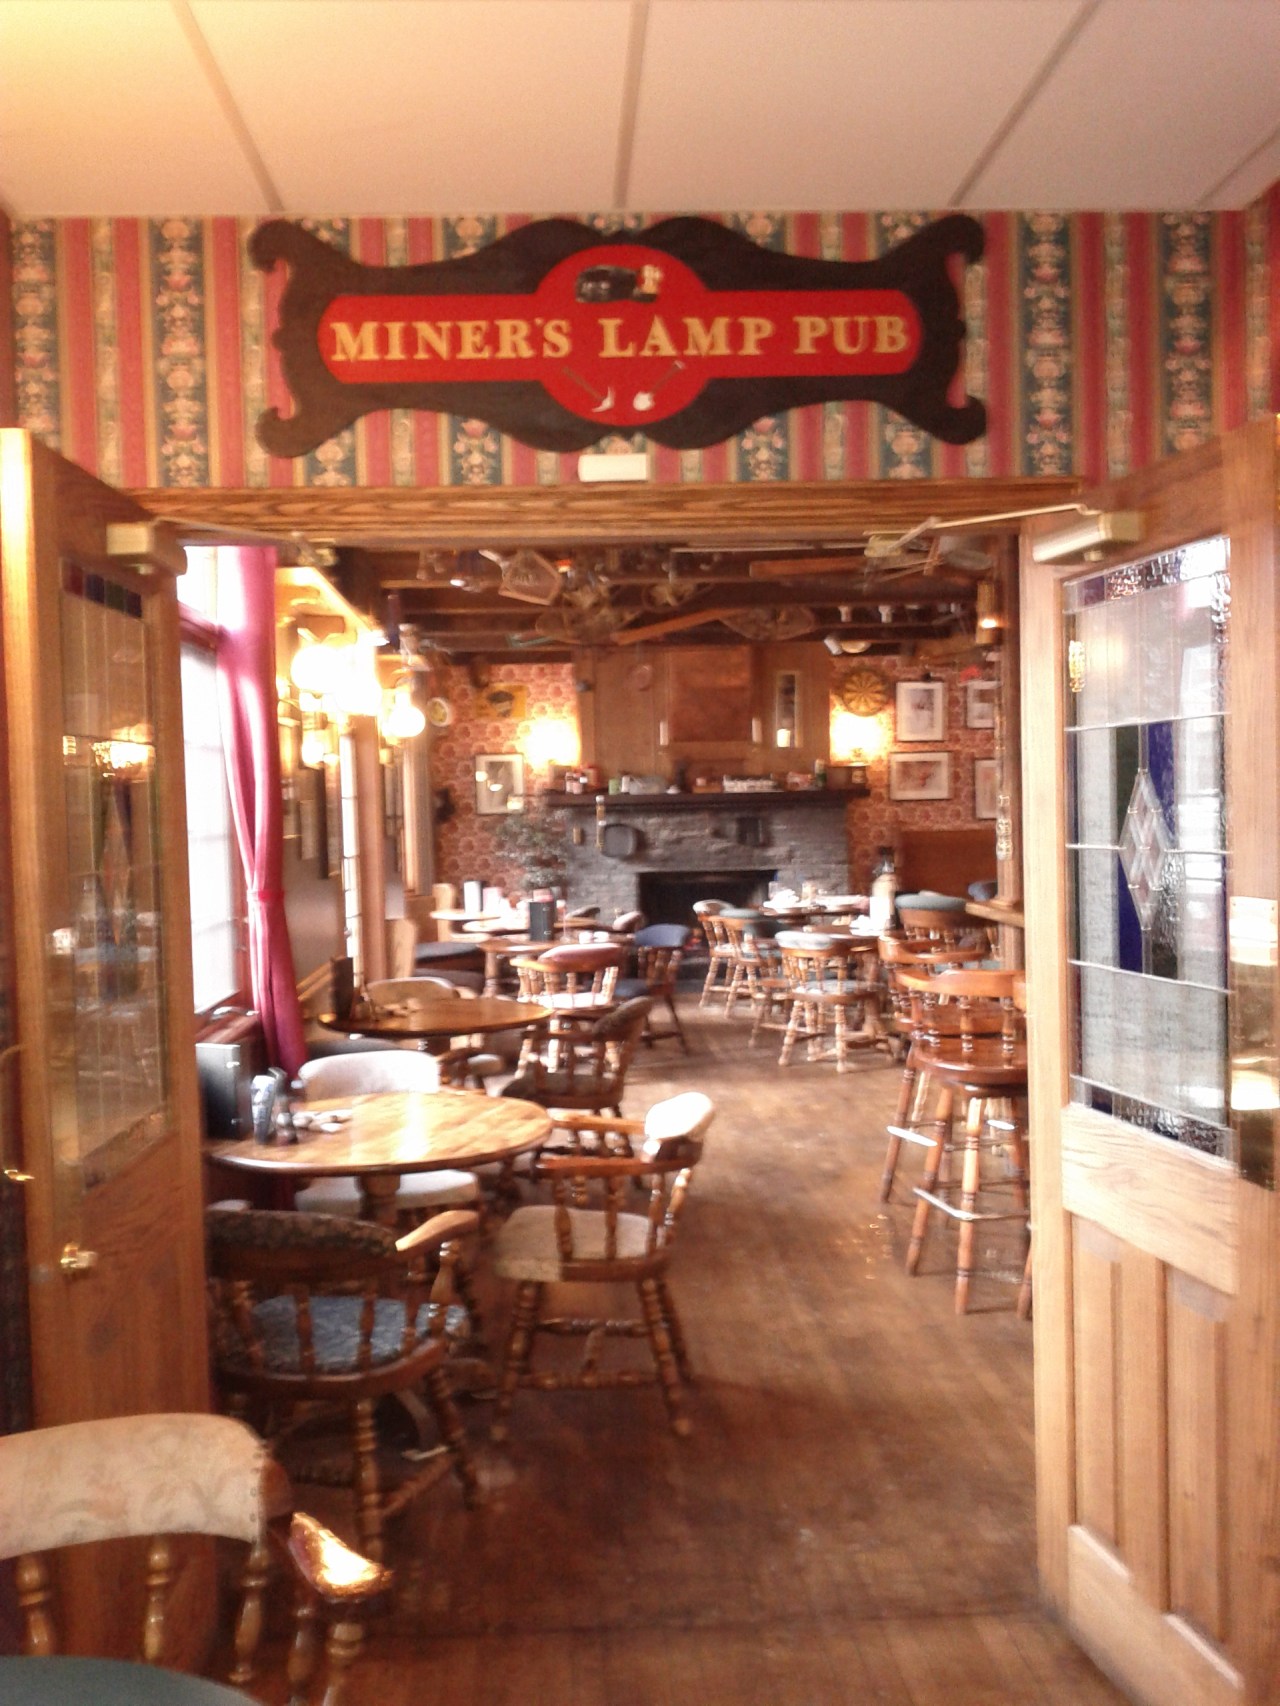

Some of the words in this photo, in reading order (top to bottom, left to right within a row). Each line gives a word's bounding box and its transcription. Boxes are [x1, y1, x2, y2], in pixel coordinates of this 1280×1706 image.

[330, 318, 572, 363] MINER'S
[598, 315, 774, 359] LAMP
[794, 314, 909, 355] PUB
